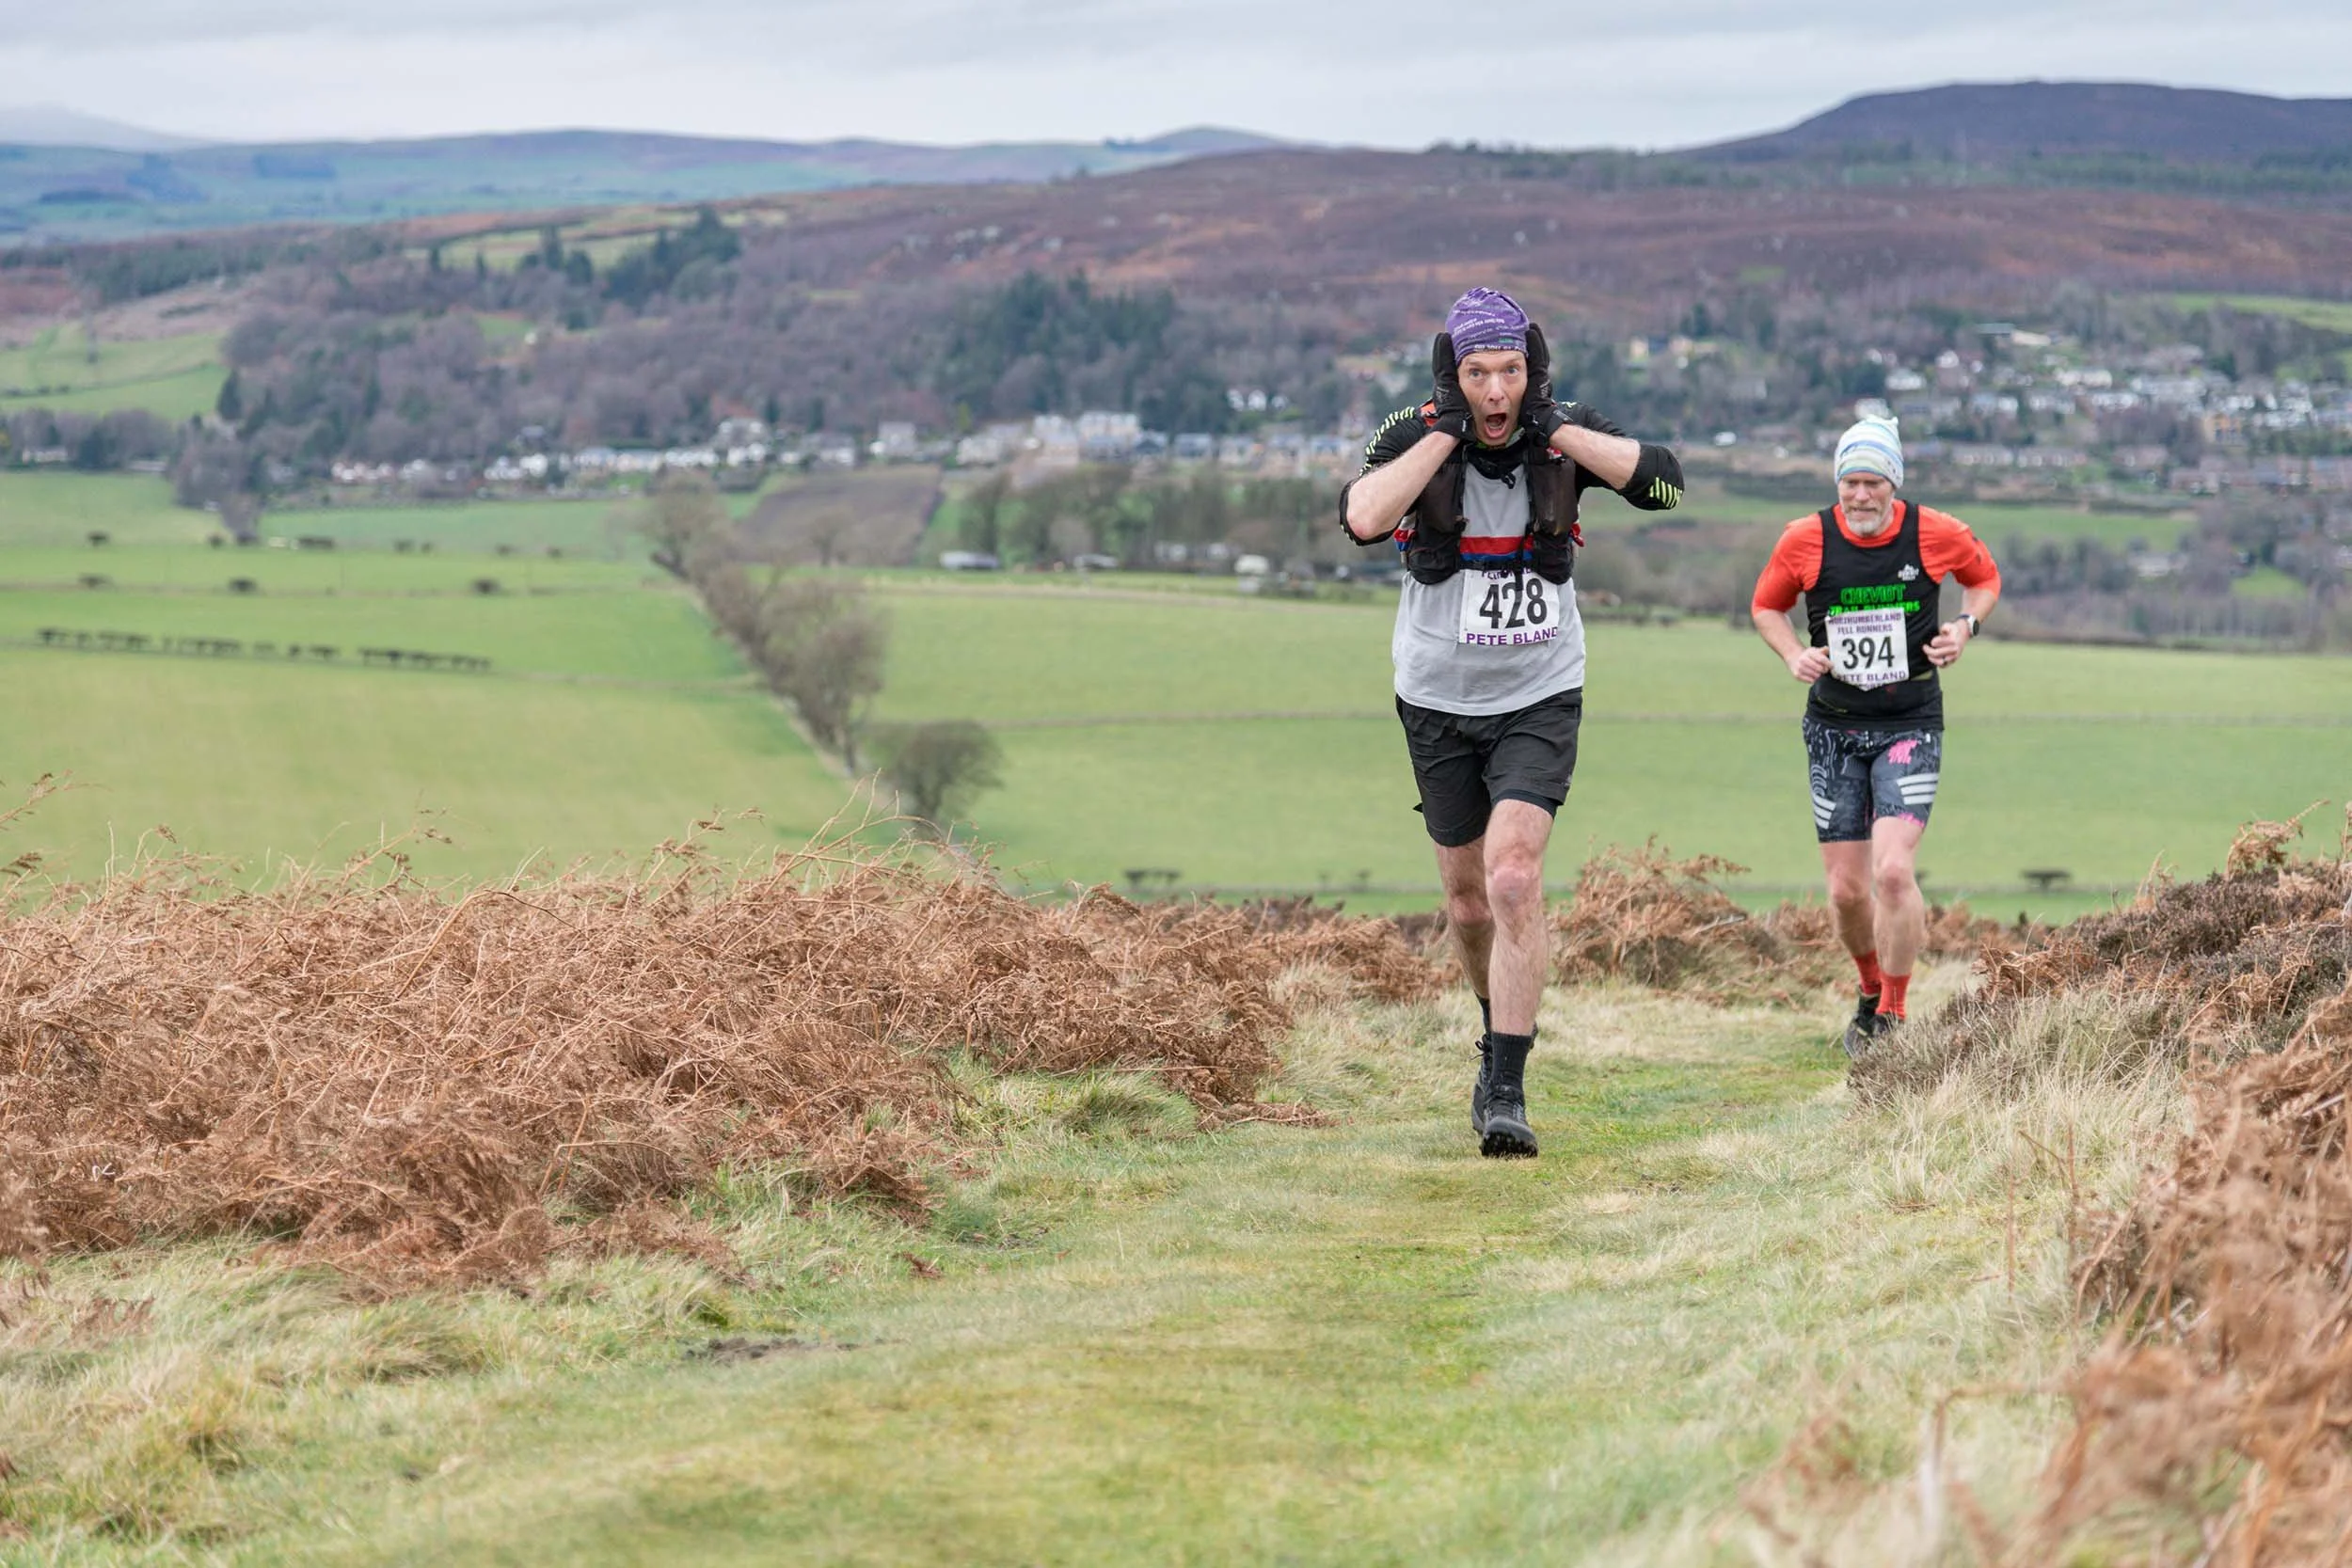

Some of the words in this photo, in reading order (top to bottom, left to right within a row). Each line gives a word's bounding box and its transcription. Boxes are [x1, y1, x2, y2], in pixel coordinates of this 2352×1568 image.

[1479, 578, 1548, 629] 428
[1466, 633, 1507, 645] PETE
[1513, 626, 1558, 644] BLAND
[1856, 624, 1893, 634] RUNNERS
[1842, 636, 1895, 670] 394
[1867, 671, 1906, 682] BLAND
